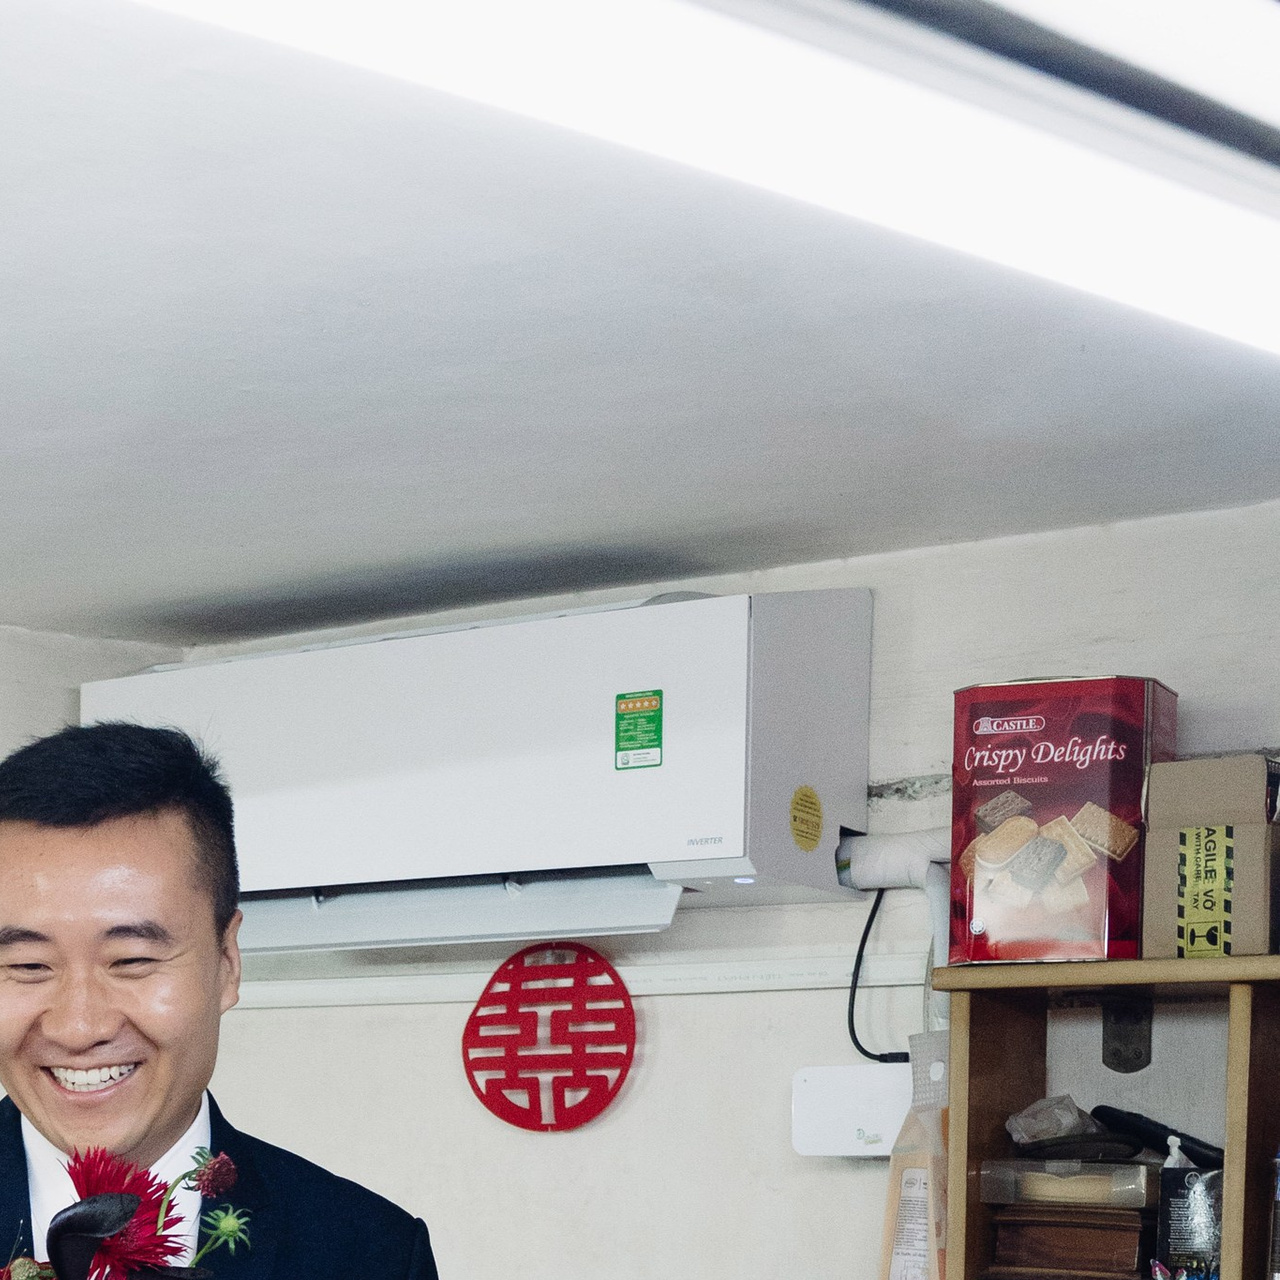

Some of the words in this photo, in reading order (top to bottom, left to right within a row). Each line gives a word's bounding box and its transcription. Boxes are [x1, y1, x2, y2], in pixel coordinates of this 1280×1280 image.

[993, 718, 1037, 731] CASTLE
[965, 744, 1026, 773] Crispy
[1031, 735, 1127, 769] Delights
[973, 777, 1011, 787] Assorted
[1013, 775, 1049, 785] Biscuits
[687, 836, 723, 846] INVERTER
